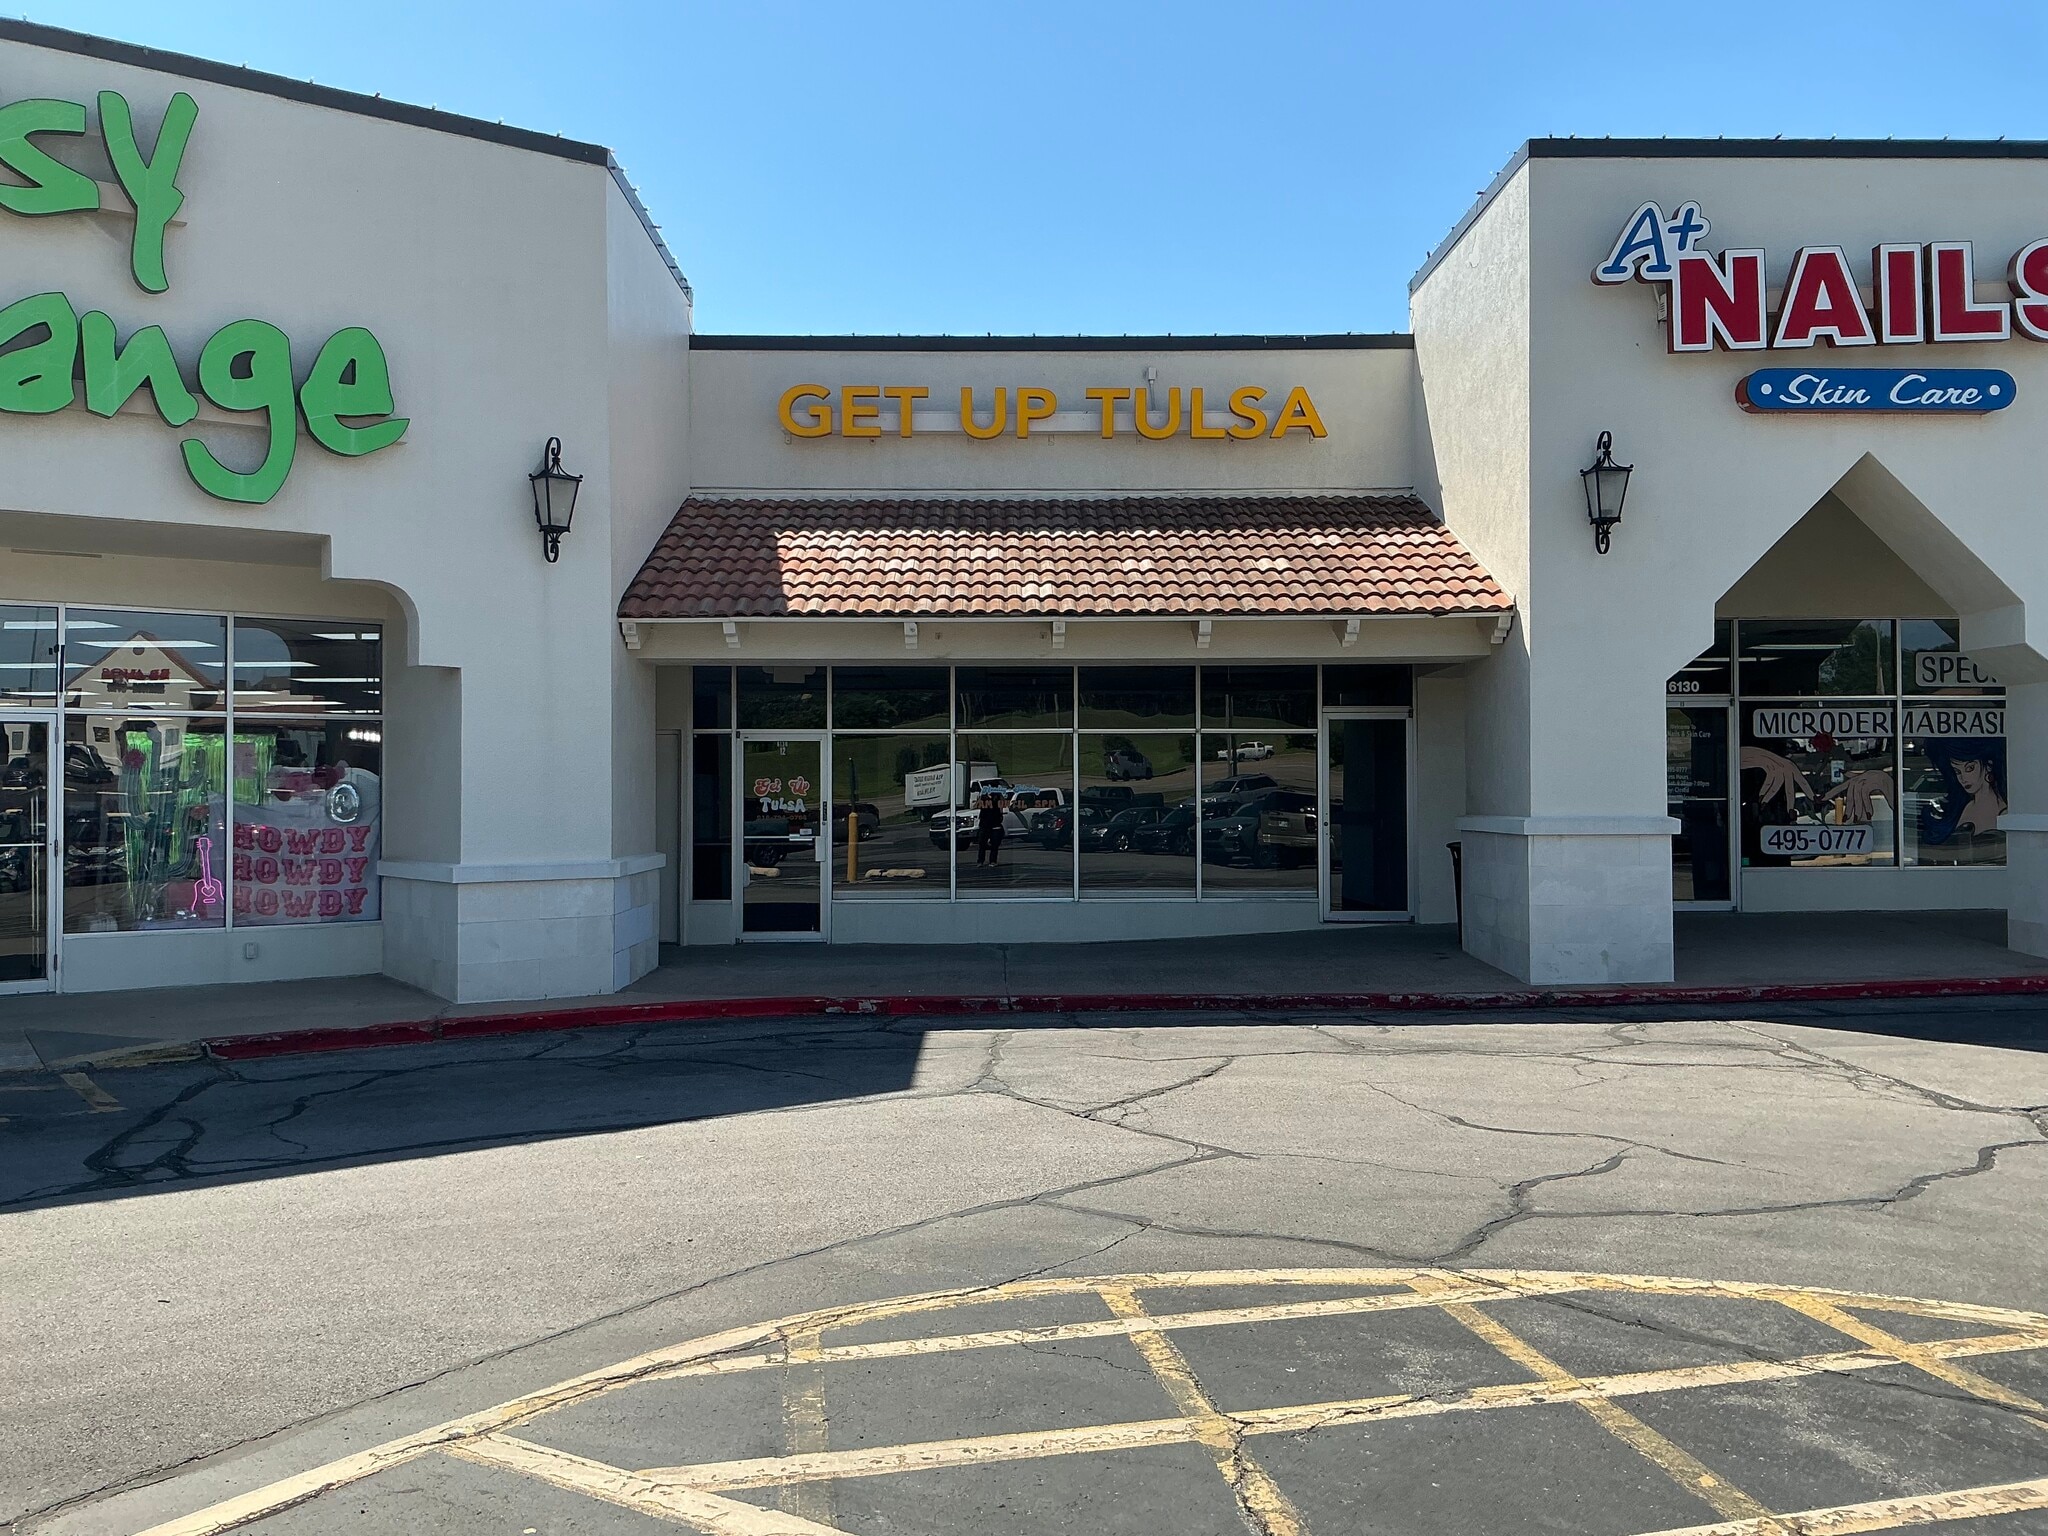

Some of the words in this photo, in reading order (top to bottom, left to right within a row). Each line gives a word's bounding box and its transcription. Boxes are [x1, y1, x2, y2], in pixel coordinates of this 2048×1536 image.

[1592, 201, 1711, 286] A+
[1779, 374, 1871, 405] Skin
[1889, 374, 1983, 405] Care
[777, 384, 929, 438] GET
[960, 386, 1057, 439] UP
[1086, 386, 1328, 440] TULSA
[1922, 656, 1997, 683] SPEC
[1668, 681, 1700, 692] 6130
[1698, 730, 1711, 738] Care
[1759, 711, 2004, 734] MICRODERMABRASI
[759, 797, 806, 813] TULSA
[233, 822, 371, 855] HOWDY
[1767, 829, 1868, 851] 495-0777
[233, 853, 369, 886] HOWDY
[233, 885, 368, 918] HOWDY
